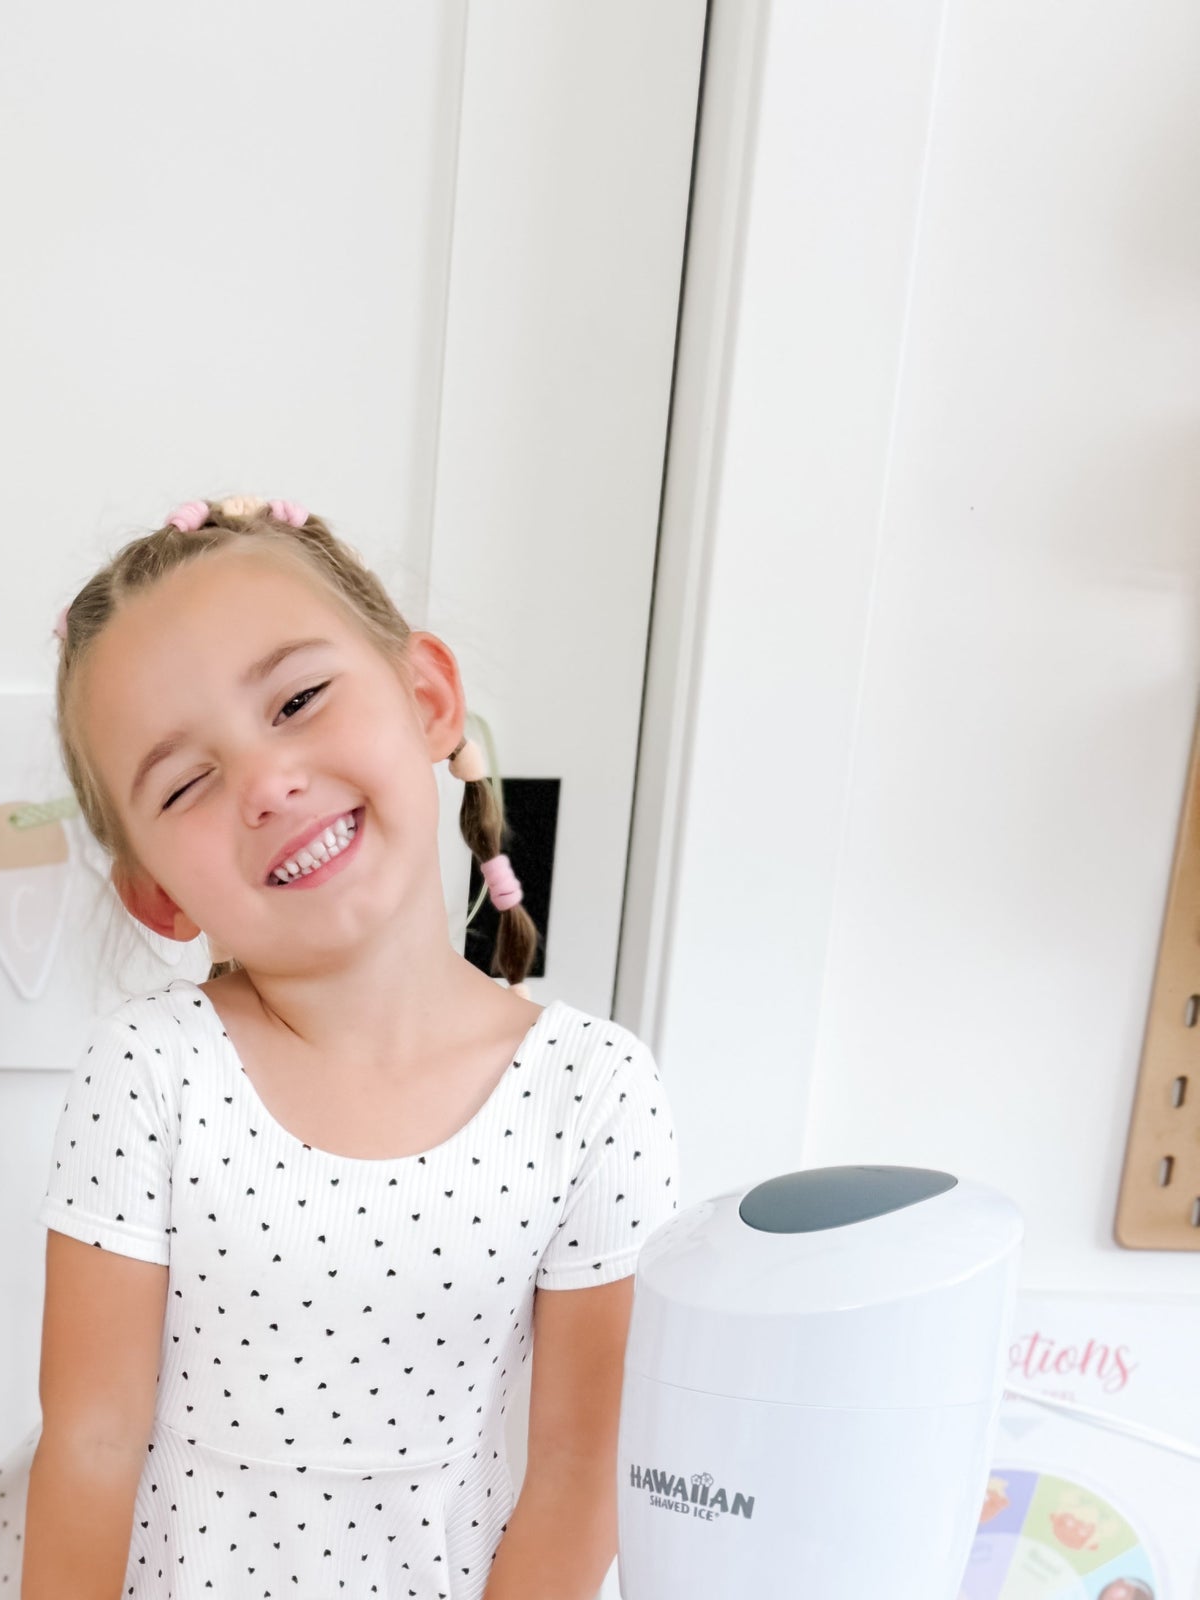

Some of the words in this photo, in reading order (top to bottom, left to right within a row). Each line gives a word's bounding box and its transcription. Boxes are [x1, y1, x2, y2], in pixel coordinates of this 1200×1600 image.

[1007, 1330, 1140, 1394] otions
[630, 1464, 755, 1519] HAWAIIAN
[649, 1495, 690, 1515] SHAVED
[693, 1508, 714, 1522] ICE
